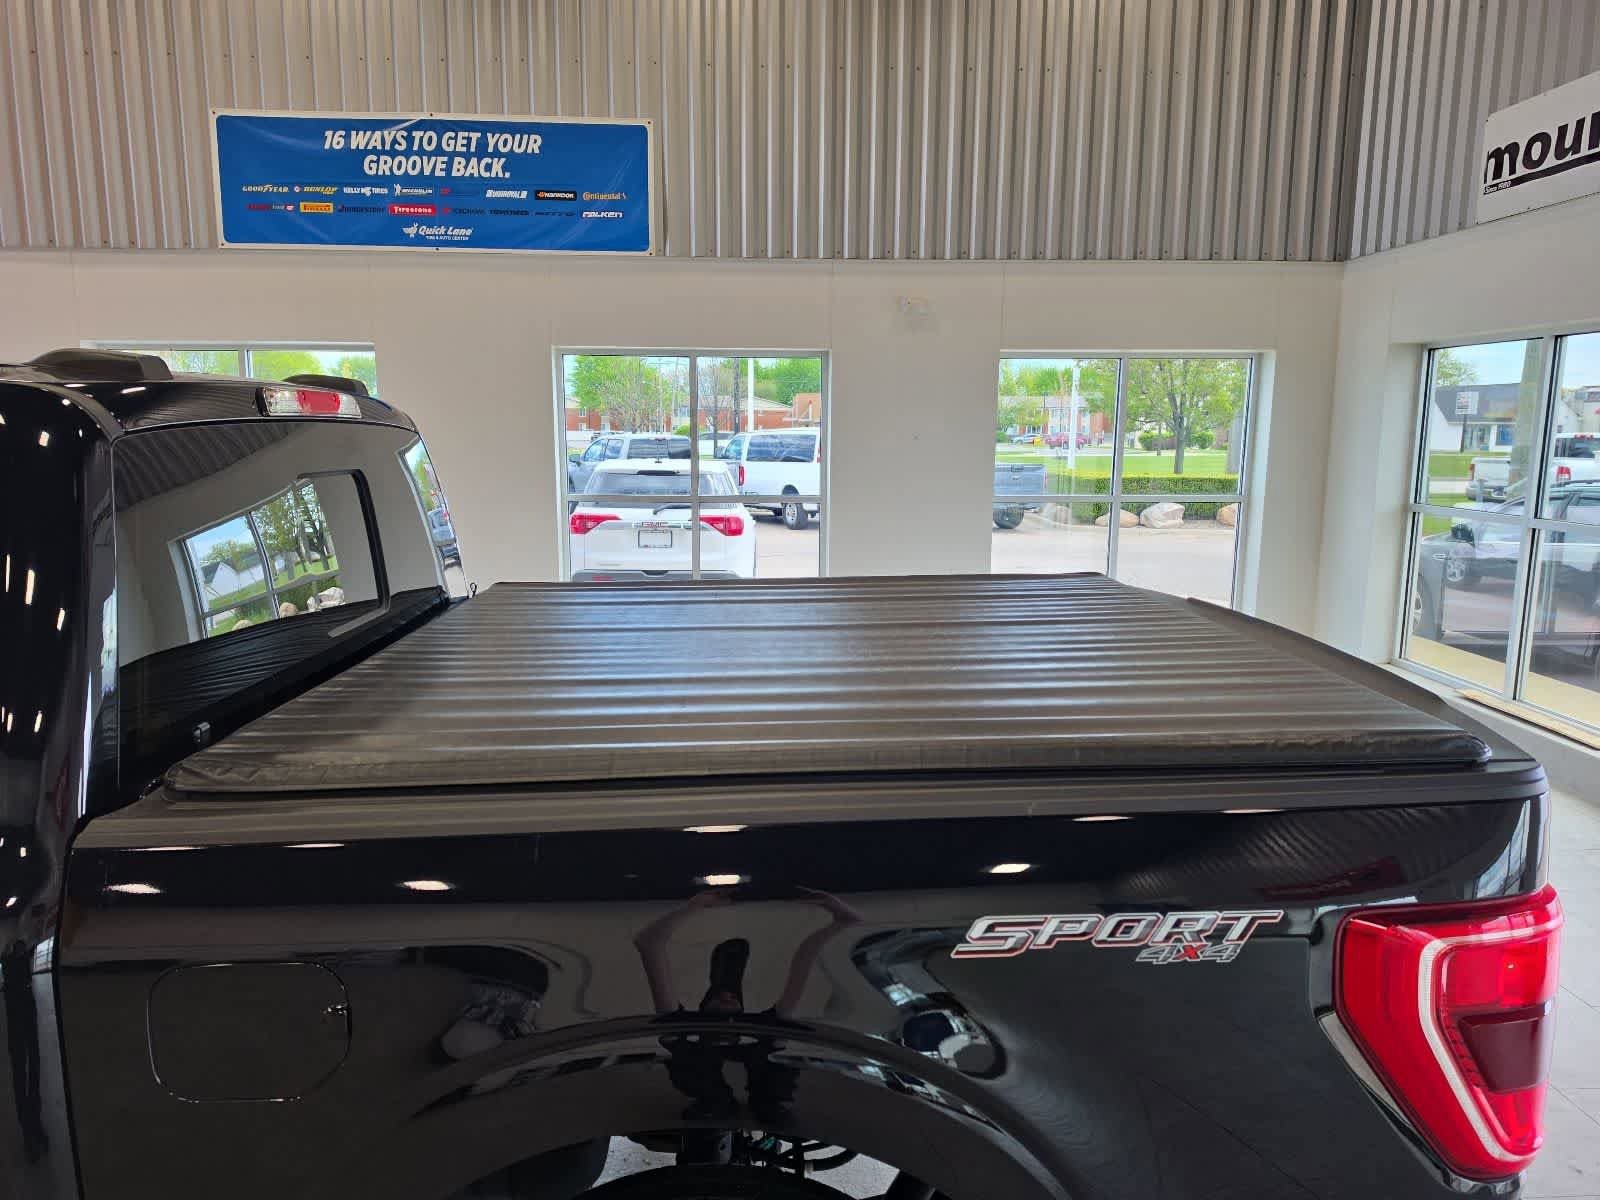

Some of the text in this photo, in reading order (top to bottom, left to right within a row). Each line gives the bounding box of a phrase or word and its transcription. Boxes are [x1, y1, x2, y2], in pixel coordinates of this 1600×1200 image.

[323, 129, 542, 154] 16 WAYS TO GET YOUR
[363, 155, 511, 178] GROOVE BACK.
[242, 184, 290, 193] GOODYEAR
[582, 191, 620, 200] Continental
[394, 205, 432, 213] Firestone
[418, 225, 473, 236] Quick Lane
[950, 910, 1284, 958] SPORT
